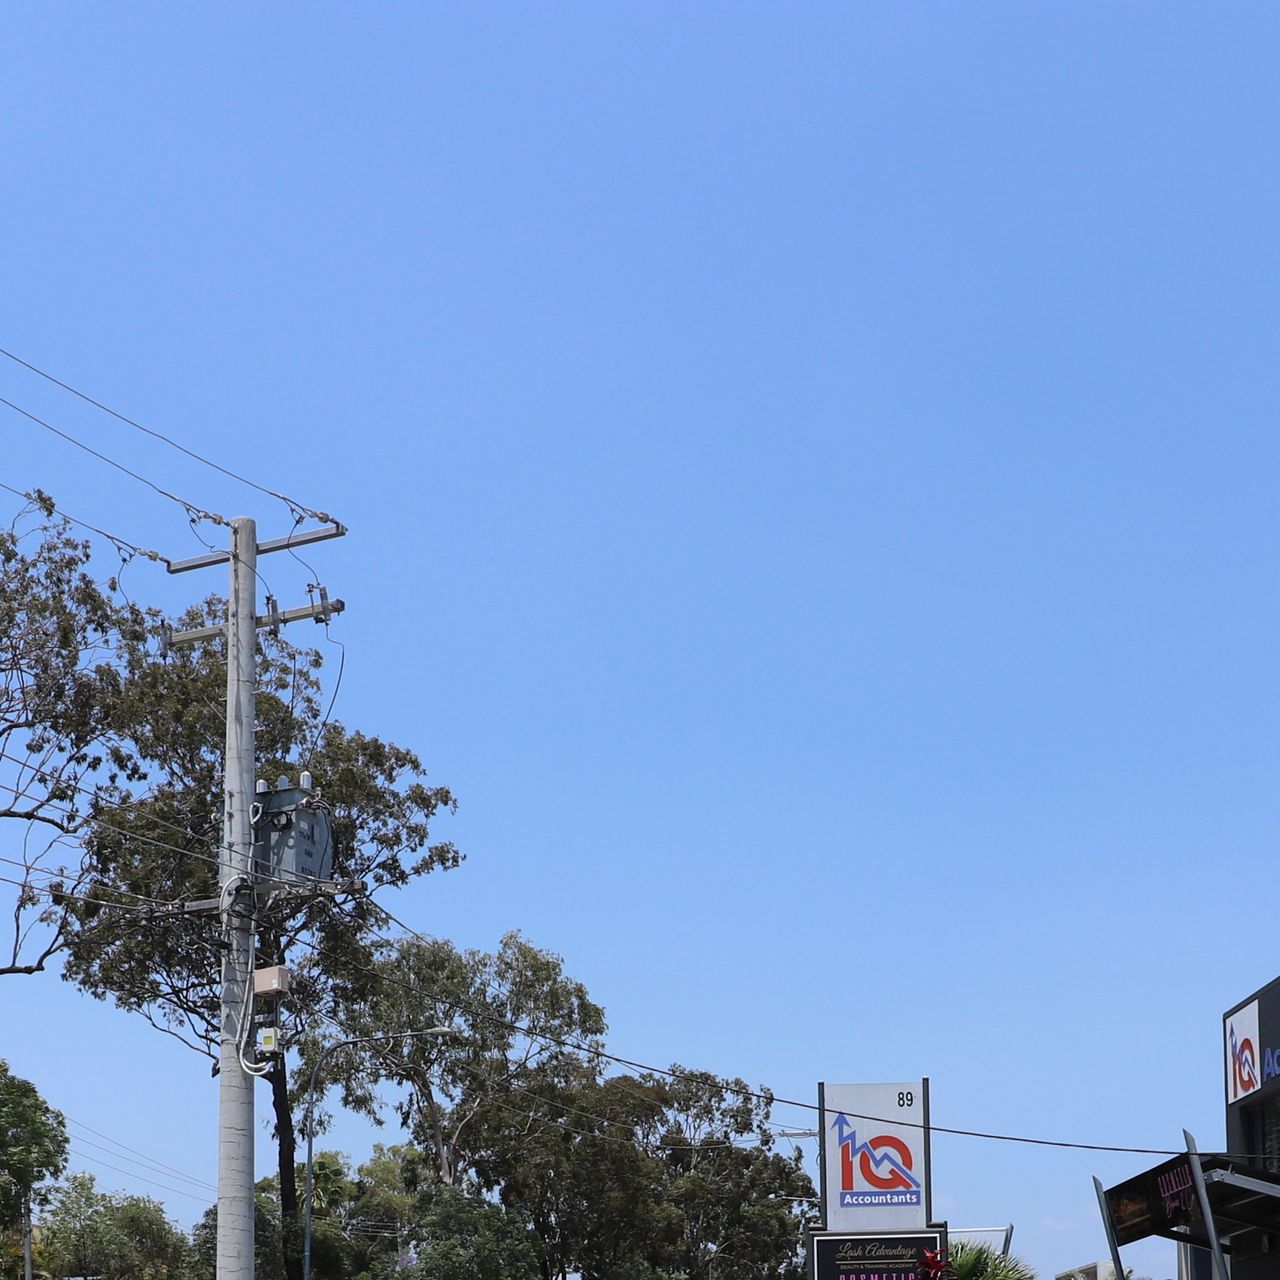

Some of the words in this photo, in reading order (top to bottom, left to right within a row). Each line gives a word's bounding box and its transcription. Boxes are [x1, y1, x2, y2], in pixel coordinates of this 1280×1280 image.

[897, 1091, 914, 1107] 89
[844, 1193, 917, 1204] Accountants
[835, 1242, 863, 1260] Lash
[865, 1242, 918, 1259] Advantage
